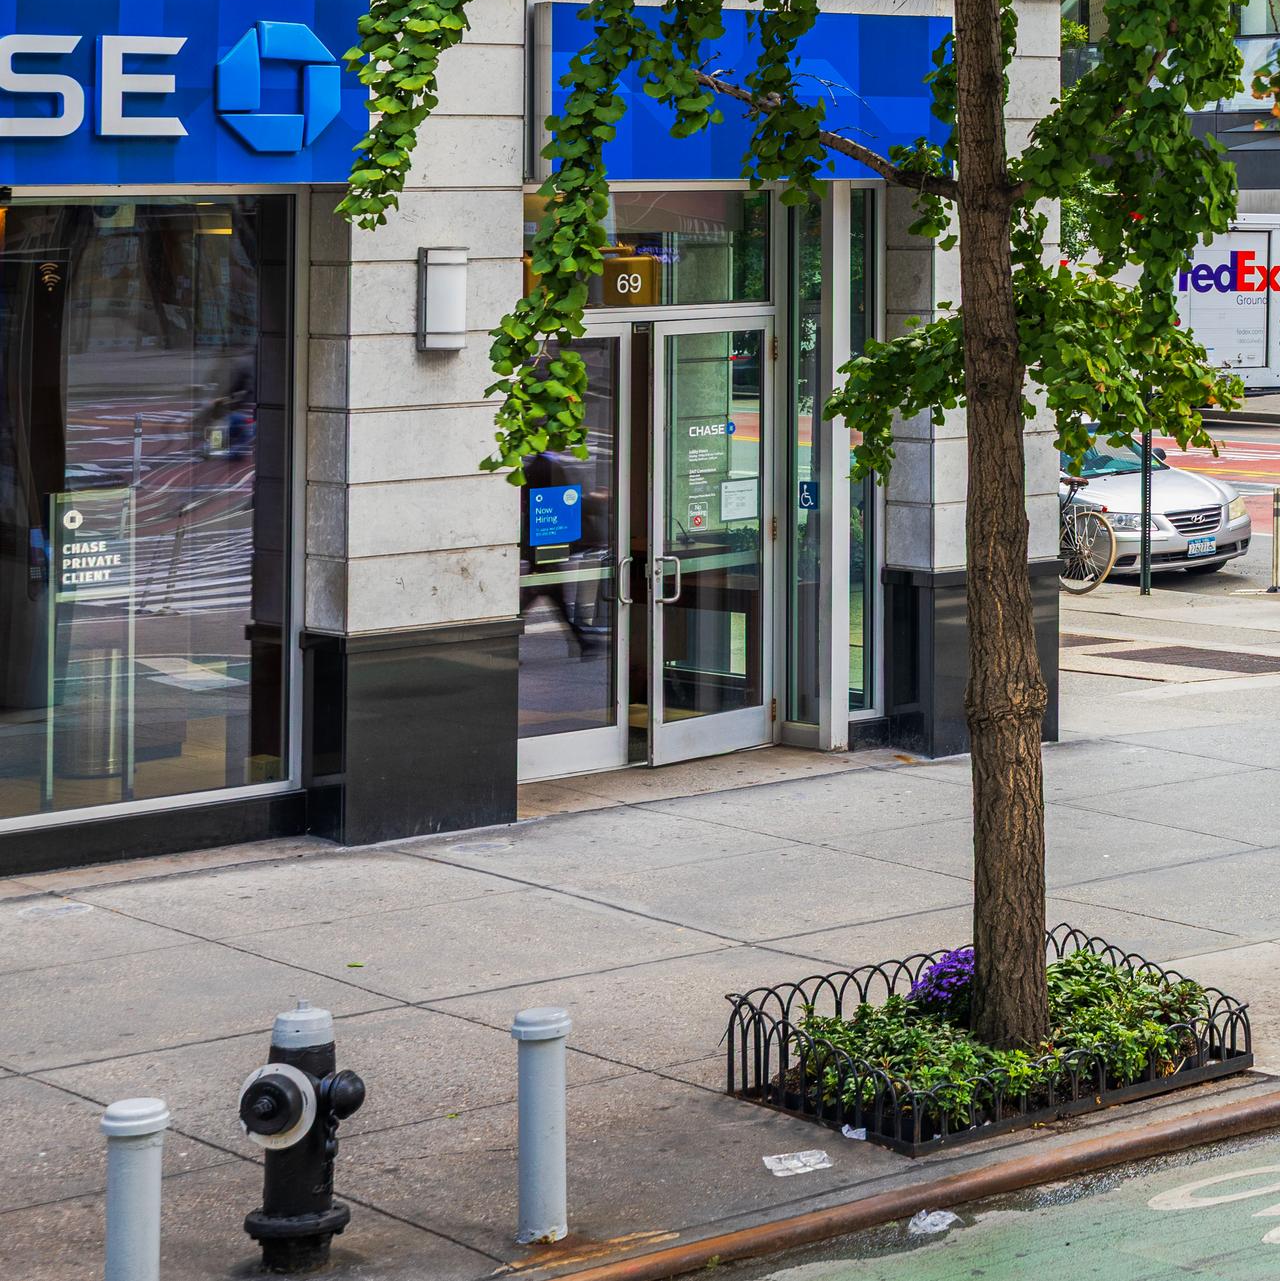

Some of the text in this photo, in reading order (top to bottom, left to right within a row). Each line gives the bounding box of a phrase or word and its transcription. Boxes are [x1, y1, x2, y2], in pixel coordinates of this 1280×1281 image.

[616, 273, 642, 294] 69
[689, 424, 725, 437] CHASE
[535, 507, 553, 515] Now
[535, 515, 558, 524] Hiring
[63, 541, 107, 554] CHASE
[63, 554, 121, 569] PRIVATE
[62, 570, 112, 584] CLIENT
